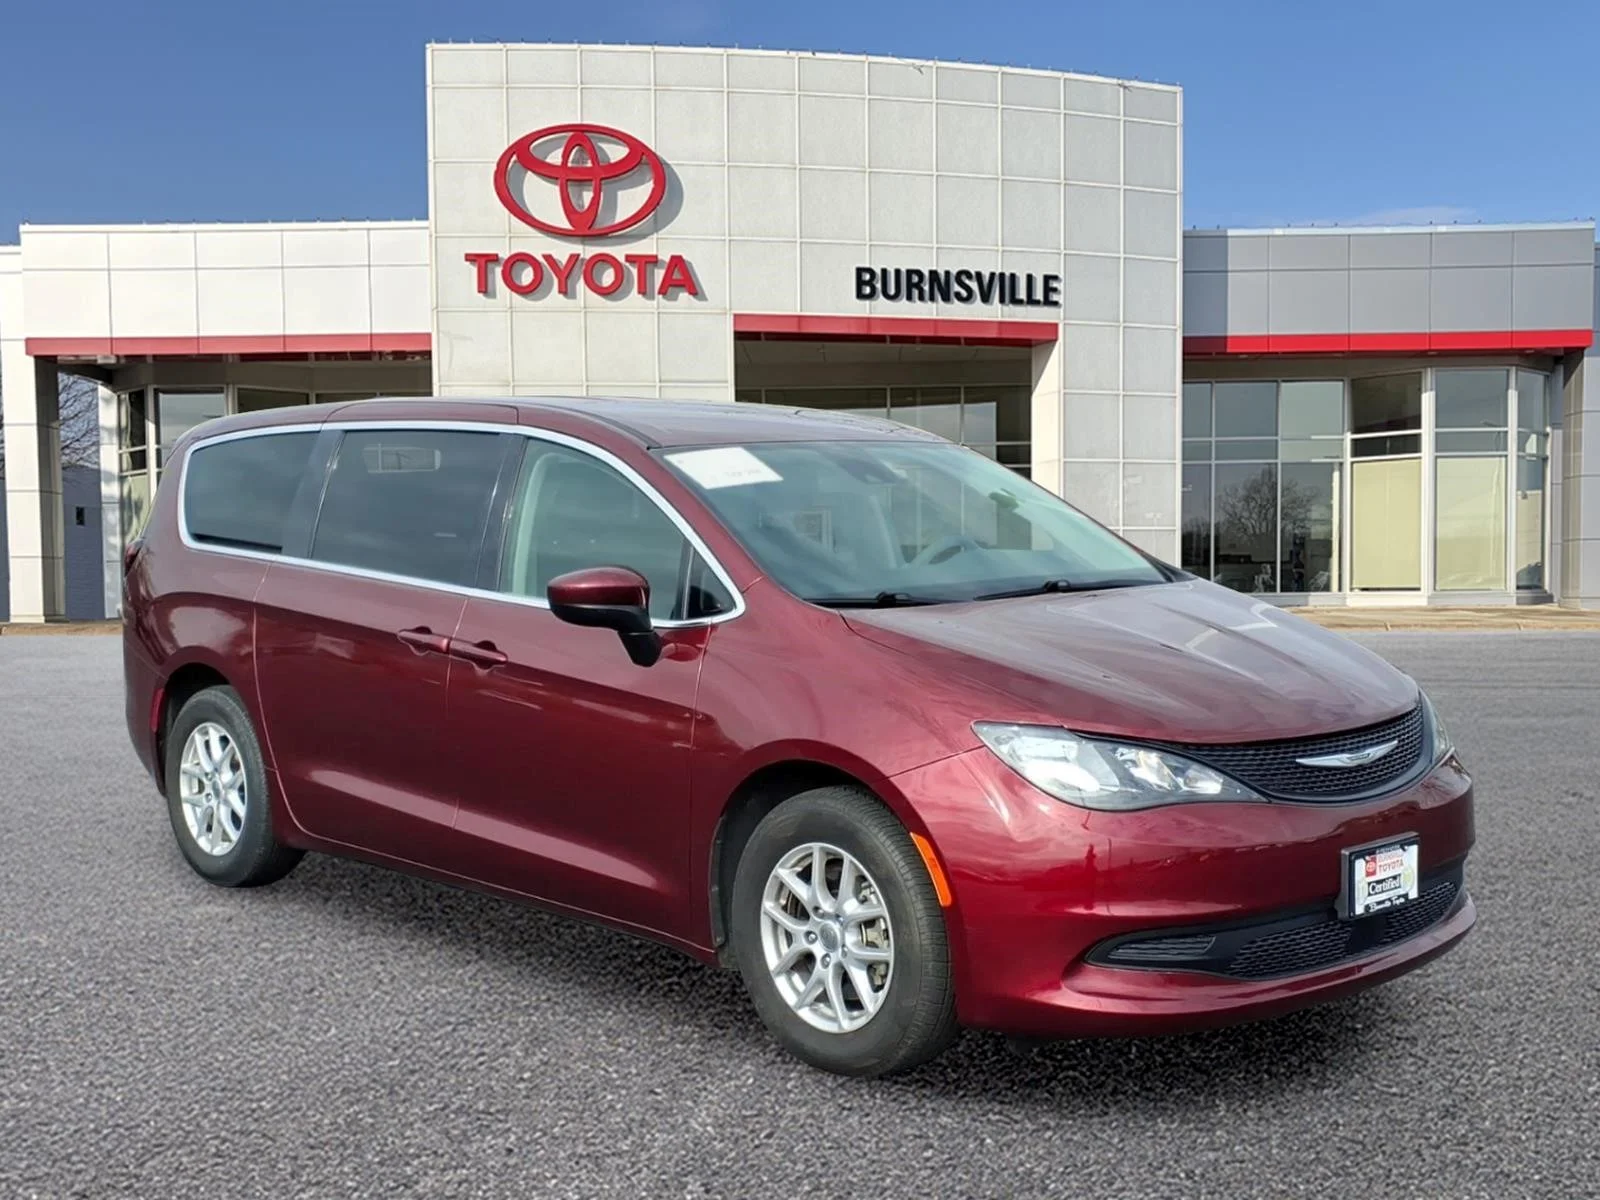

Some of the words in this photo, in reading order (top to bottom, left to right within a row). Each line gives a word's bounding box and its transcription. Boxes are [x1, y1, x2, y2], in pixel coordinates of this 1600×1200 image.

[465, 252, 697, 296] TOYOTA
[855, 267, 1061, 307] BURNSVILLE
[1378, 858, 1404, 873] TOYOTA
[1369, 875, 1400, 894] Certified
